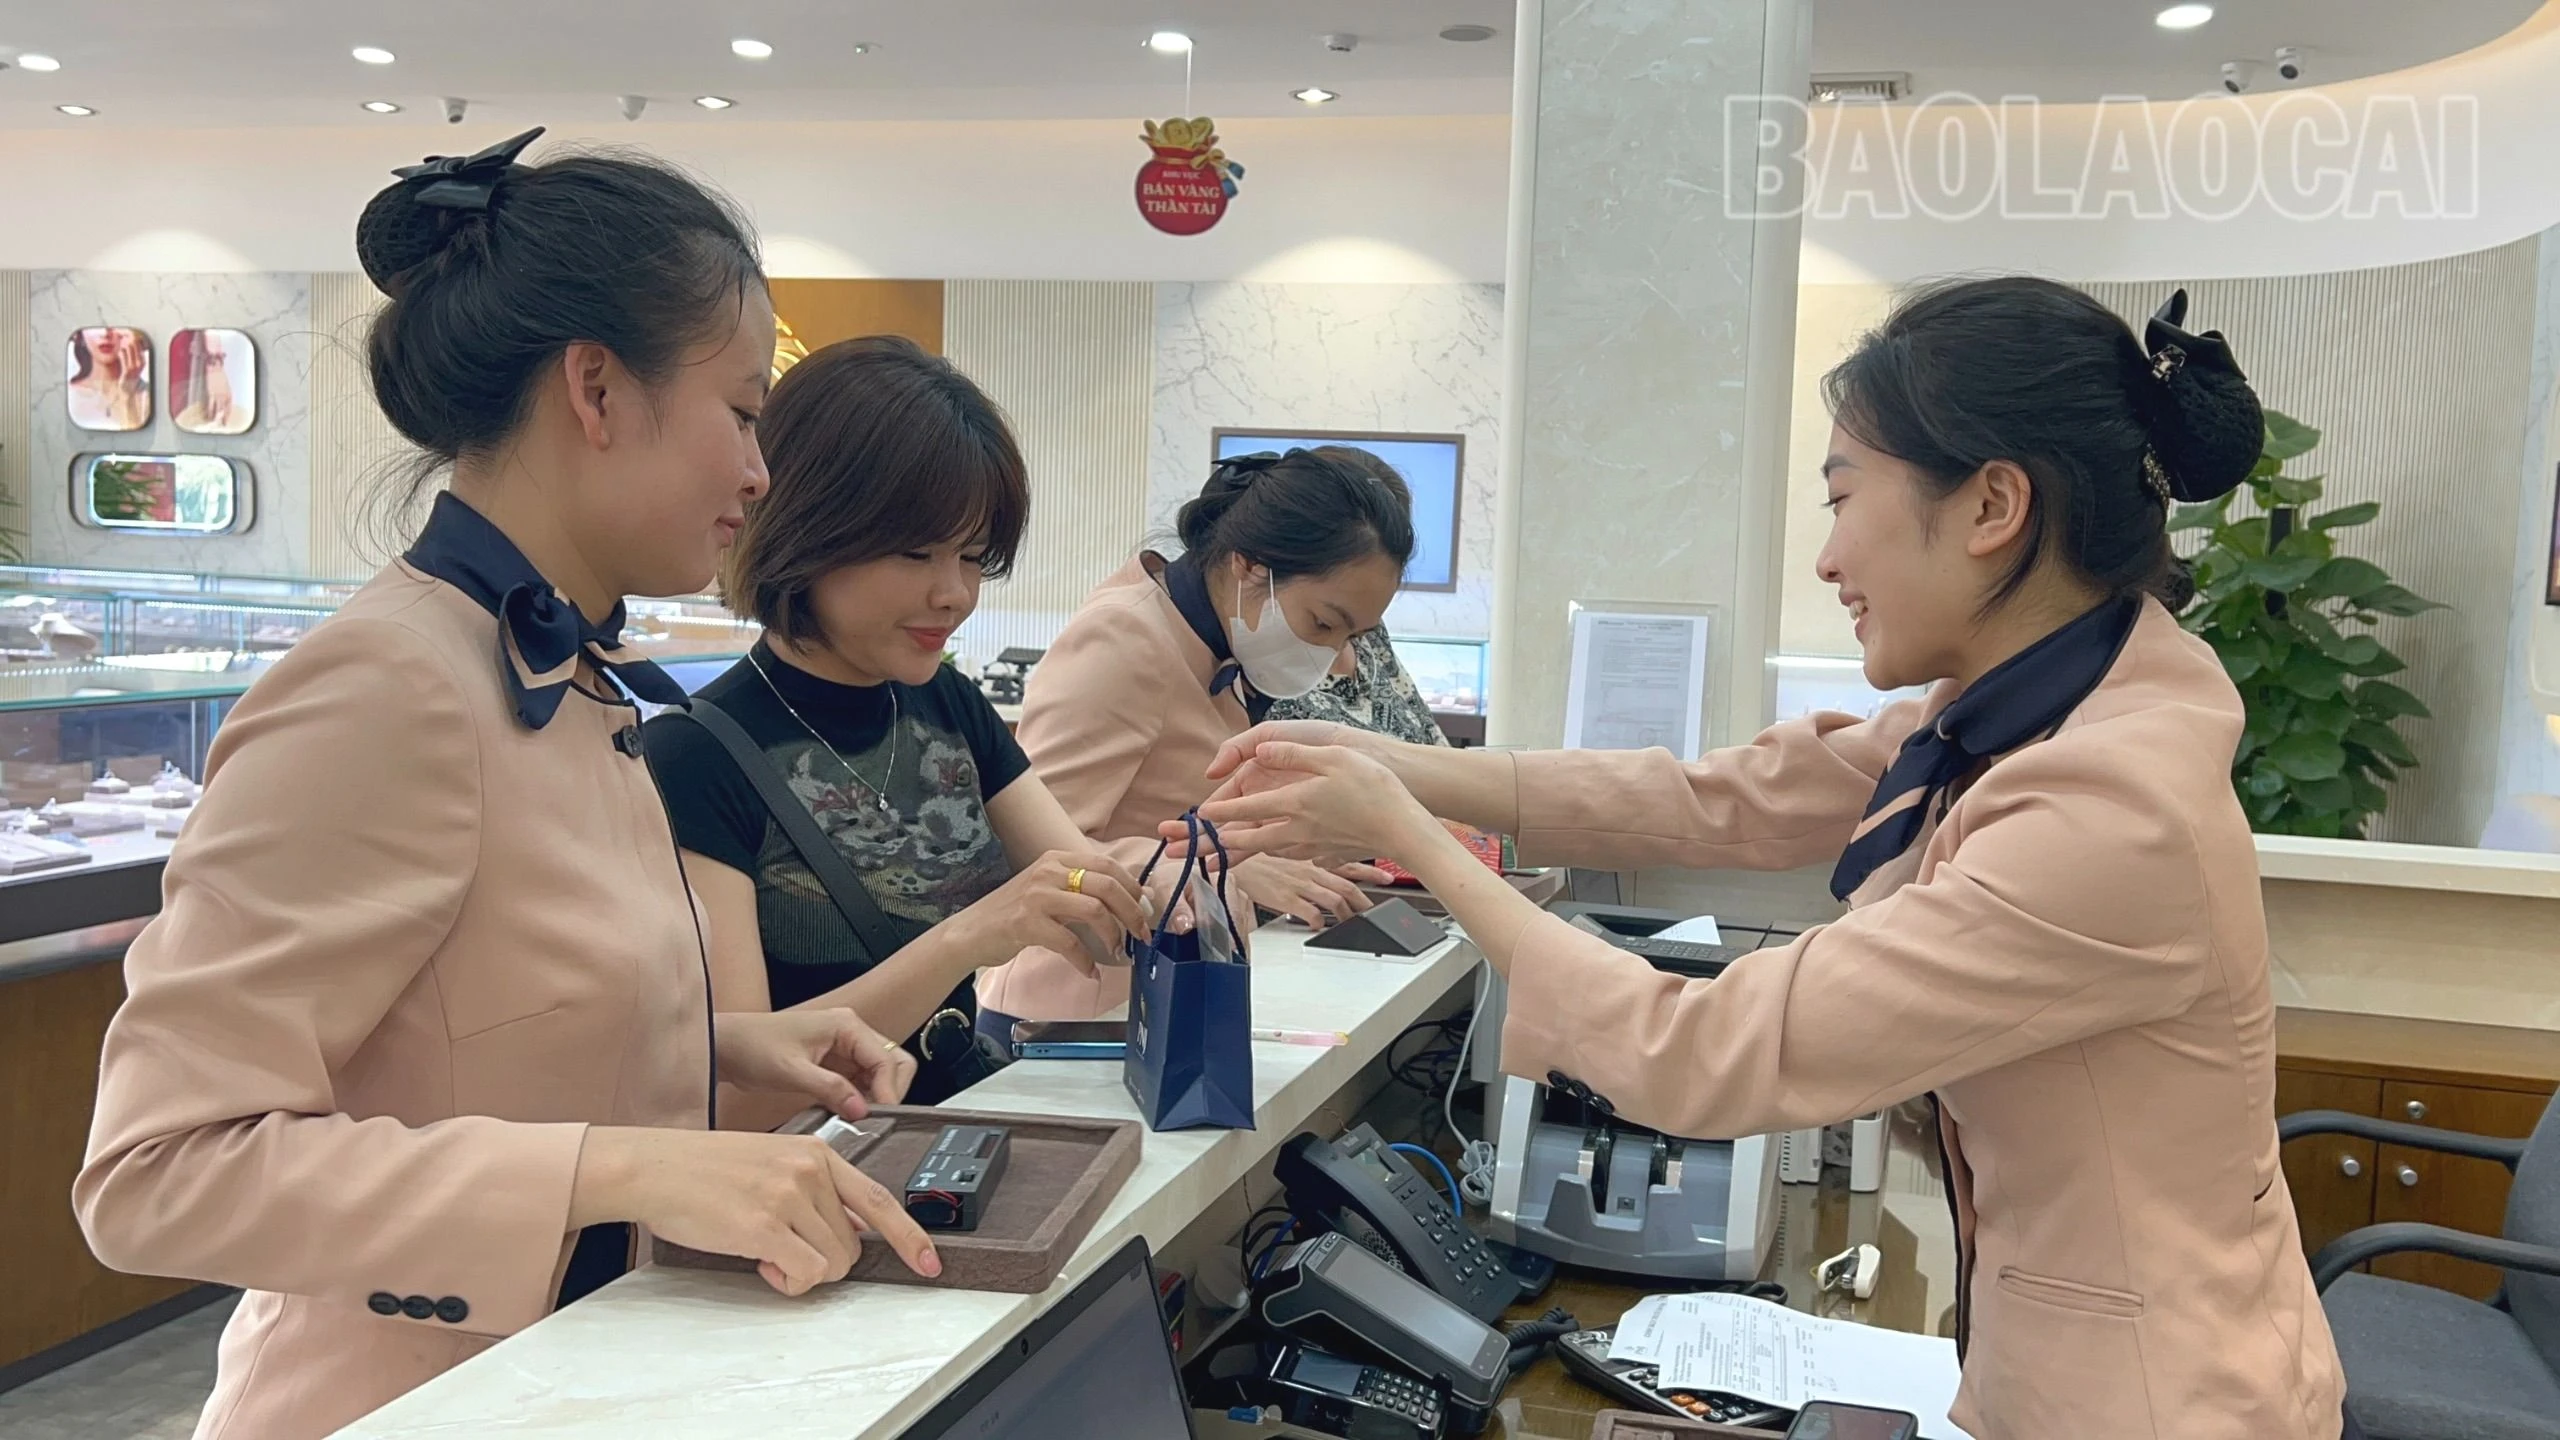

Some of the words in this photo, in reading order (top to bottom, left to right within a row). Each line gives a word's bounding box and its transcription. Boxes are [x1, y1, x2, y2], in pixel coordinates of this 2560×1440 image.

[1143, 182, 1176, 197] BÁN
[1177, 183, 1221, 199] VÀNG
[1191, 201, 1217, 216] TÀI
